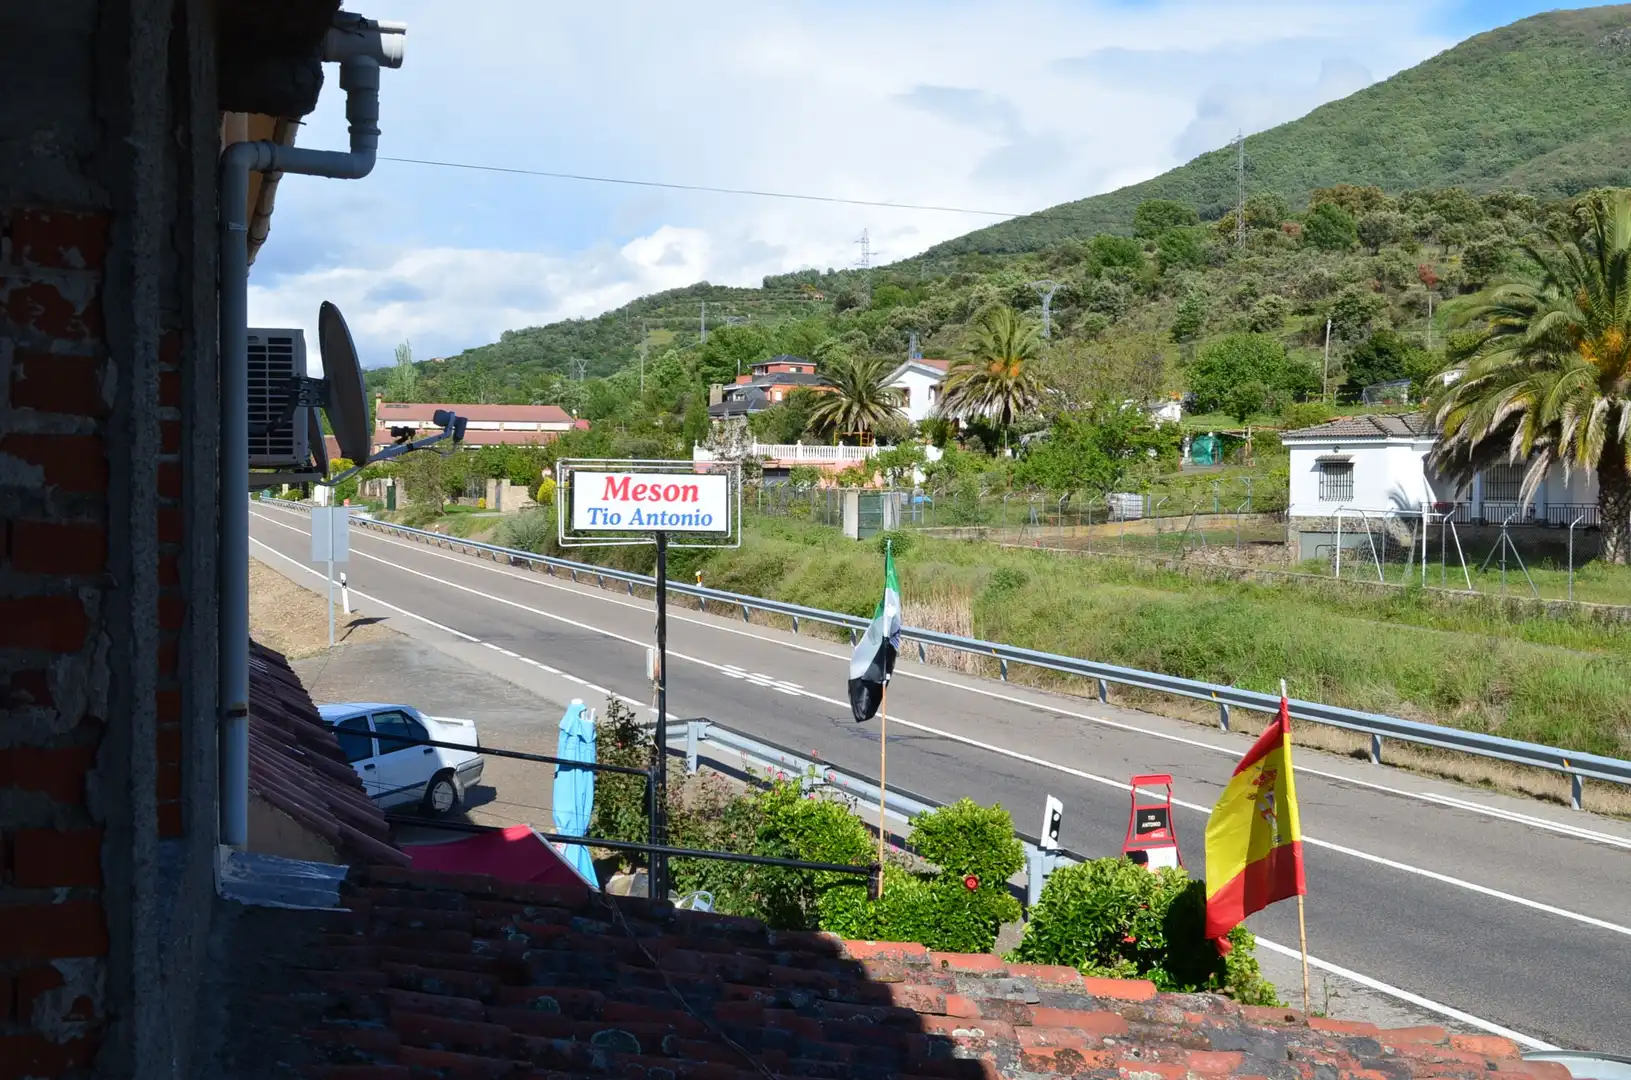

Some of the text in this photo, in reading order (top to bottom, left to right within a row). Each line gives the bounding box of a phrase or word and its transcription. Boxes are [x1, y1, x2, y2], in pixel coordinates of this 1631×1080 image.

[601, 476, 699, 502] Meson
[587, 507, 713, 527] Tio Antonio
